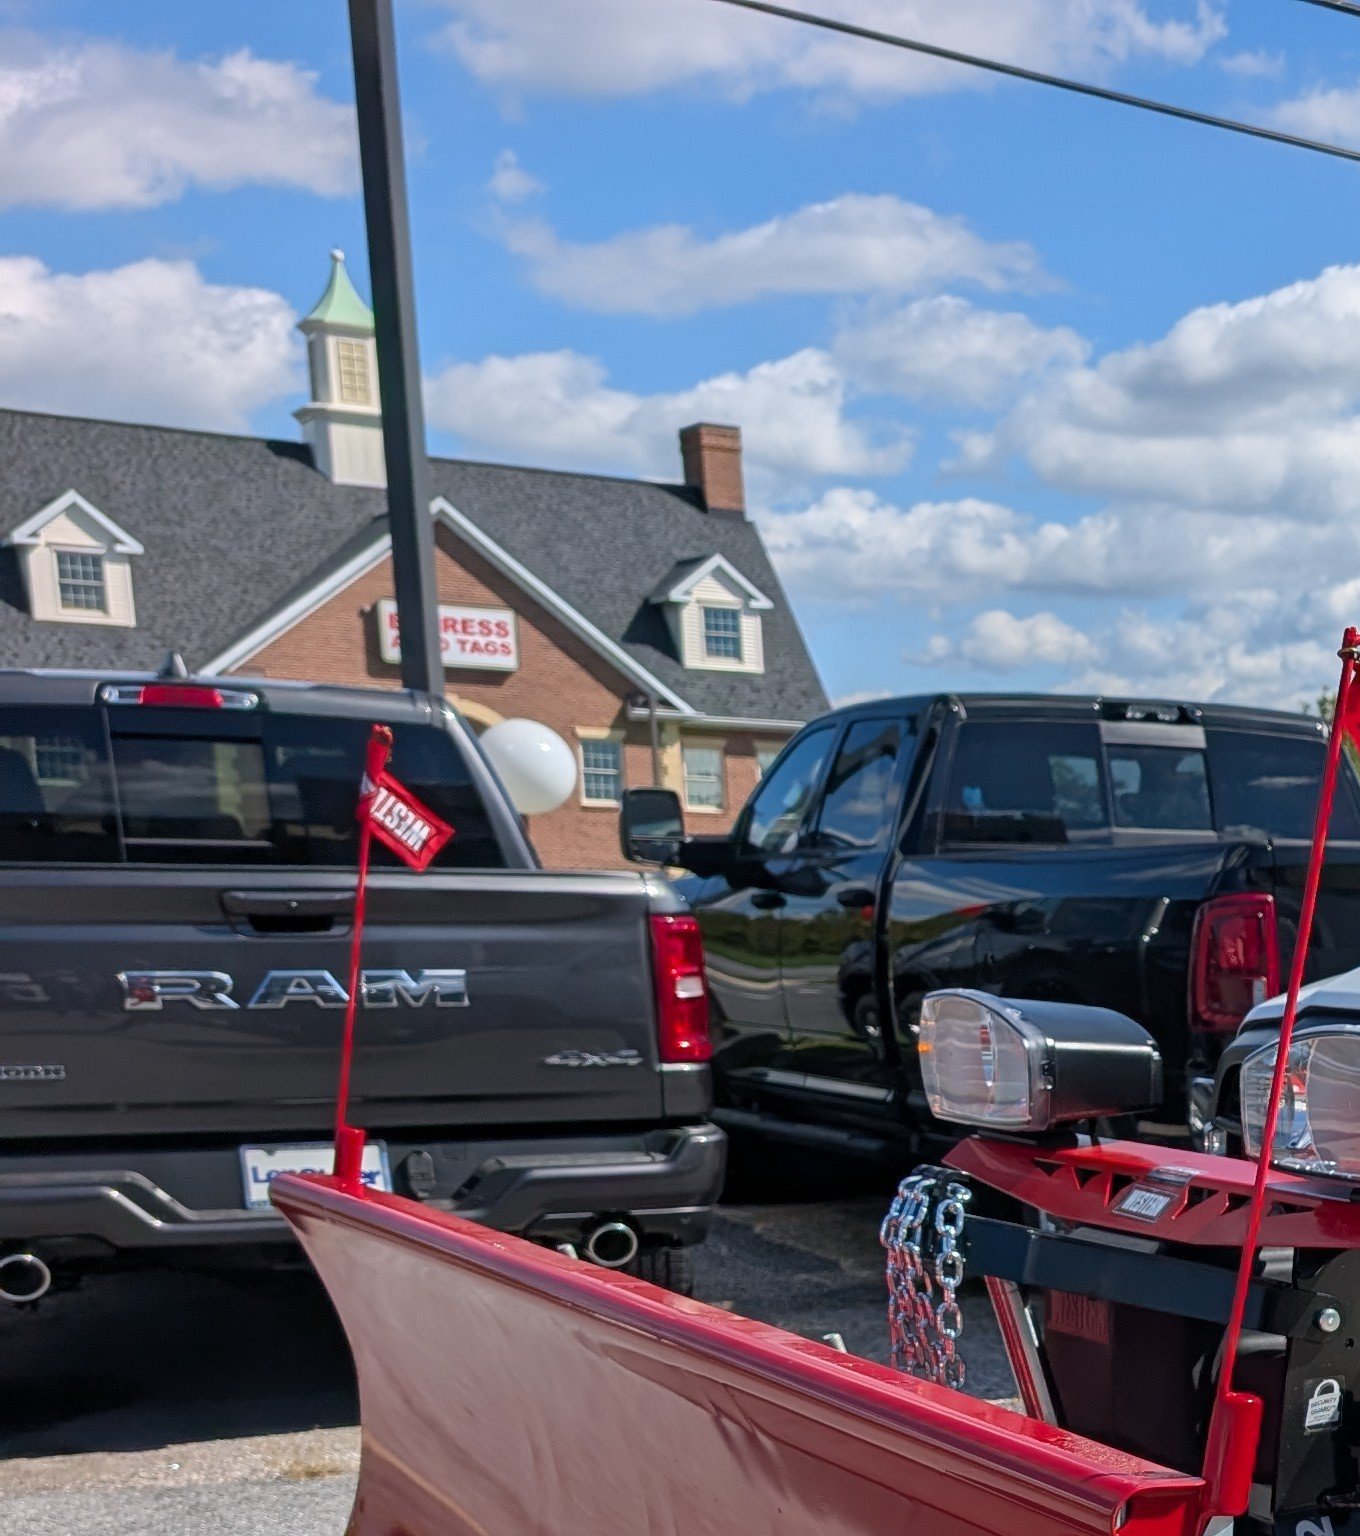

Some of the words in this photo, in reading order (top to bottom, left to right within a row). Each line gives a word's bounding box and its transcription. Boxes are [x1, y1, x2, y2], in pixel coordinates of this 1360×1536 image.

[388, 612, 510, 639] ERESS
[456, 638, 513, 656] TAGS
[115, 968, 470, 1010] RAM
